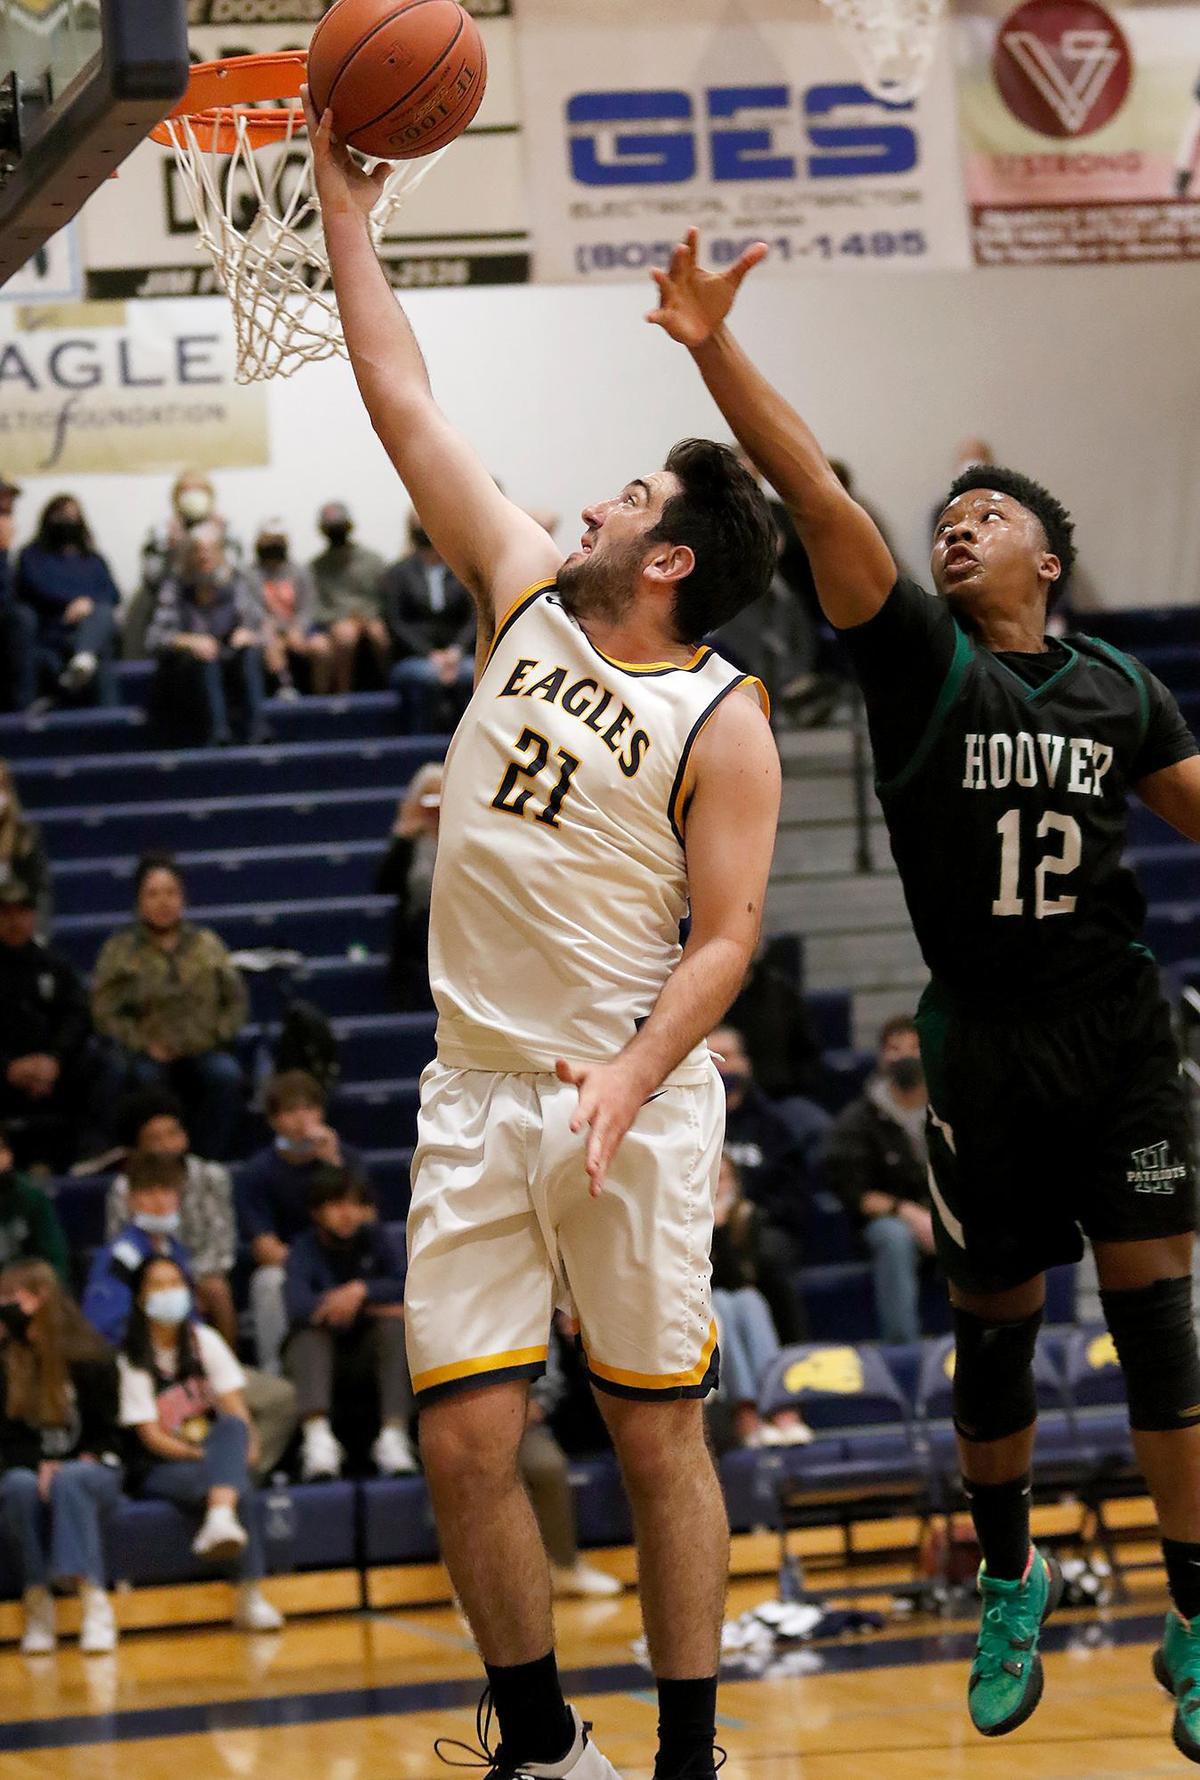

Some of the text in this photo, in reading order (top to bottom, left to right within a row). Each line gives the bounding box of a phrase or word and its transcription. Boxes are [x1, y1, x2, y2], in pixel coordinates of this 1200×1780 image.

[566, 82, 919, 187] GES
[496, 658, 651, 779] EAGLES
[962, 731, 1114, 797] HOOVER
[488, 724, 584, 831] 21
[991, 808, 1083, 920] 12
